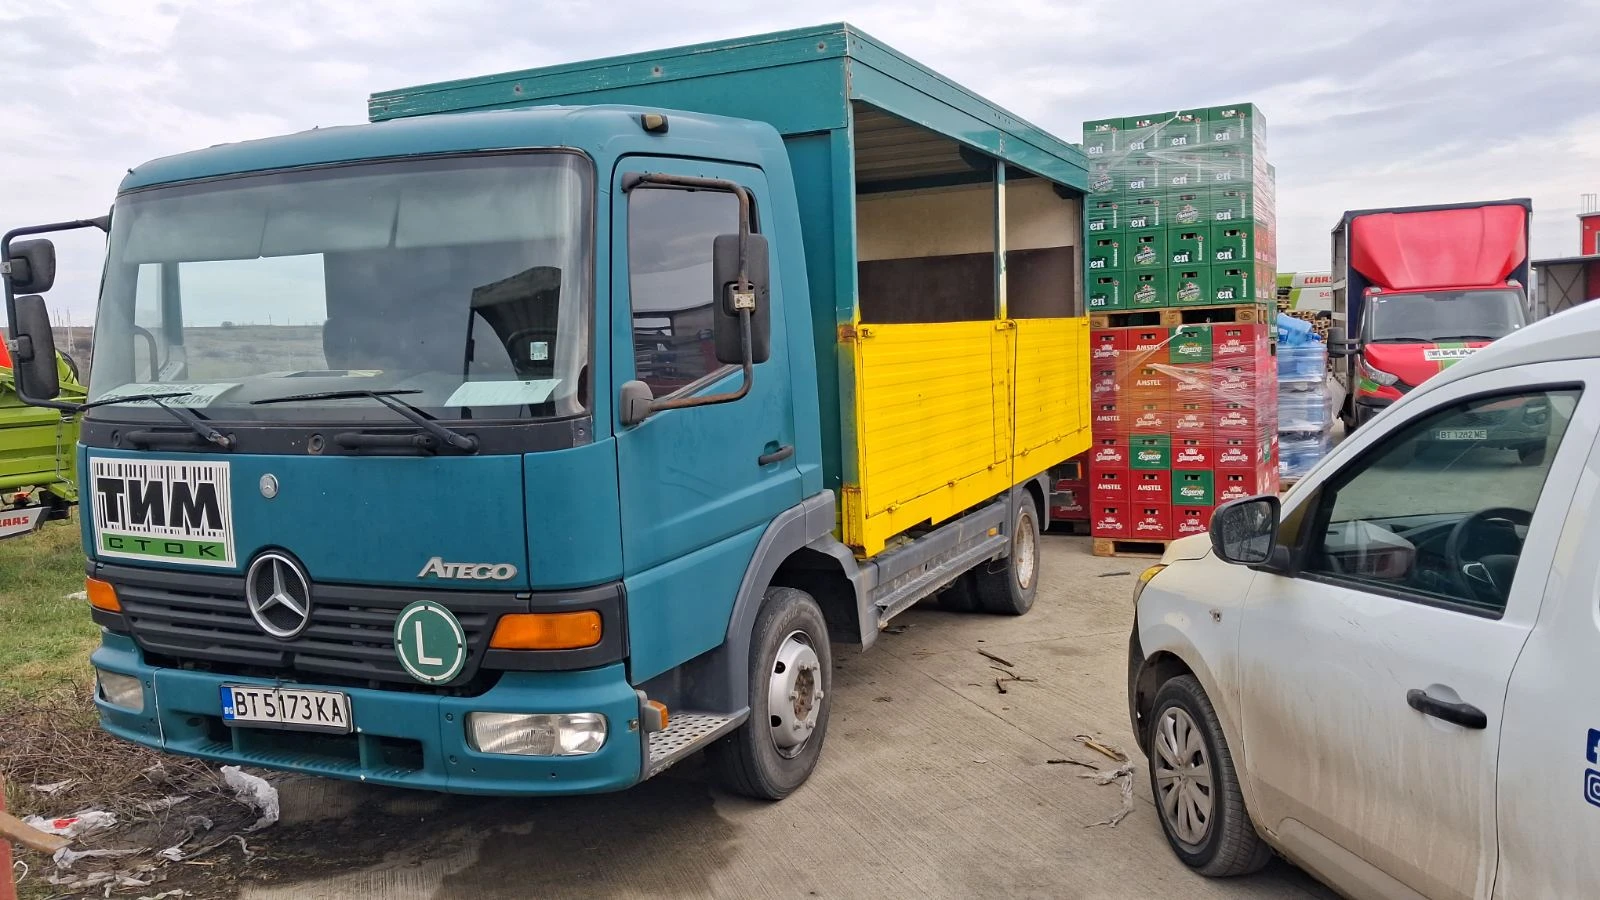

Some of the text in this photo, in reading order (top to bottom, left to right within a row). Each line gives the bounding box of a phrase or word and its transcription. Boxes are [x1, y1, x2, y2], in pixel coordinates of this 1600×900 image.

[97, 478, 224, 531] ТИМ
[108, 537, 217, 558] СТОК
[417, 556, 518, 581] ATEGO
[415, 620, 442, 666] L
